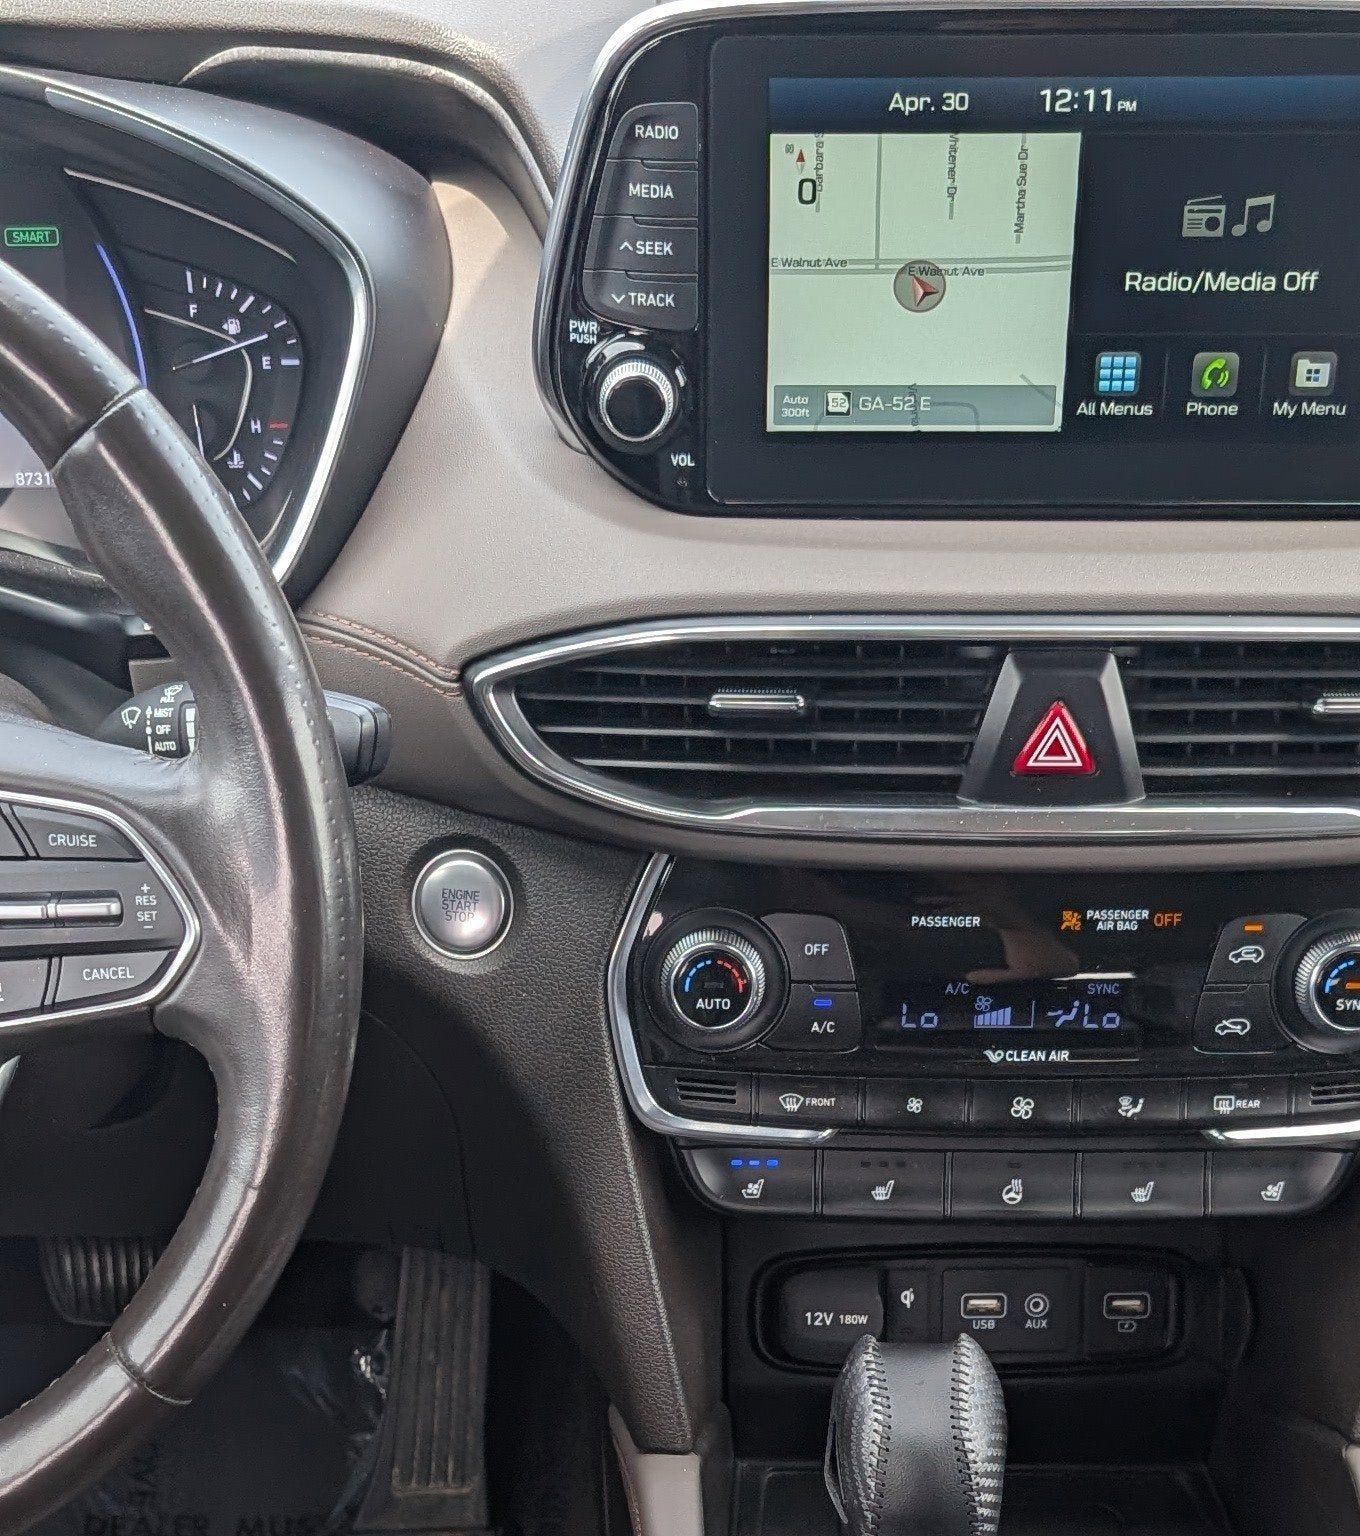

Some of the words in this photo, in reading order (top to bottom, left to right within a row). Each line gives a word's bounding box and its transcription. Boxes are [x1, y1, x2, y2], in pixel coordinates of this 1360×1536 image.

[888, 92, 935, 116] Apr.
[941, 92, 969, 111] 30
[1040, 89, 1112, 113] 12:11
[1117, 100, 1137, 112] PM
[635, 124, 679, 140] RADIO
[1018, 145, 1028, 160] Dr
[1017, 163, 1028, 187] Sue
[628, 183, 674, 199] MEDIA
[798, 177, 817, 205] 0
[947, 187, 957, 202] Dr
[1014, 189, 1026, 233] Martha
[11, 230, 53, 244] SMART
[635, 241, 674, 256] SEEK
[771, 258, 778, 267] E
[781, 258, 822, 267] Walnut
[825, 258, 847, 267] Ave
[908, 267, 915, 276] E
[962, 266, 985, 276] Ave
[1125, 271, 1276, 293] Radio/Media
[1283, 271, 1320, 292] Off
[628, 292, 675, 307] TRACK
[189, 304, 198, 318] F
[569, 320, 598, 334] PWR
[569, 333, 597, 344] PUSH
[262, 356, 271, 370] E
[783, 395, 809, 404] Auto
[831, 398, 847, 408] 52
[859, 396, 915, 411] GA-52
[920, 396, 931, 411] E
[781, 408, 810, 418] 300ft
[1076, 402, 1096, 416] All
[1099, 402, 1153, 416] Menus
[1186, 402, 1238, 416] Phone
[1272, 402, 1294, 419] My
[1300, 402, 1346, 416] Menu
[251, 419, 261, 433] H
[670, 452, 695, 468] VOL
[154, 707, 174, 718] MIST
[156, 725, 171, 735] OFF
[154, 741, 176, 752] AUTO
[48, 834, 97, 847] CRUISE
[135, 895, 157, 906] RES
[441, 888, 480, 901] ENGINE
[441, 899, 479, 912] START
[137, 911, 157, 922] SET
[445, 911, 475, 922] STOP
[911, 915, 981, 928] PASSENGER
[1086, 909, 1149, 921] PASSENGER
[1153, 912, 1183, 928] OFF
[1096, 921, 1115, 931] AIR
[1117, 921, 1139, 931] BAG
[804, 944, 829, 955] OFF
[82, 967, 134, 981] CANCEL
[945, 982, 970, 996] A/C
[1087, 983, 1120, 995] SYNC
[696, 998, 731, 1010] AUTO
[811, 1021, 836, 1034] A/C
[1005, 1050, 1045, 1062] CLEAN
[1048, 1050, 1069, 1062] AIR
[805, 1098, 836, 1107] FRONT
[1235, 1099, 1261, 1109] REAR
[804, 1311, 834, 1326] 12V
[838, 1313, 868, 1325] 180W
[972, 1319, 995, 1330] USB
[1025, 1319, 1048, 1329] AUX
